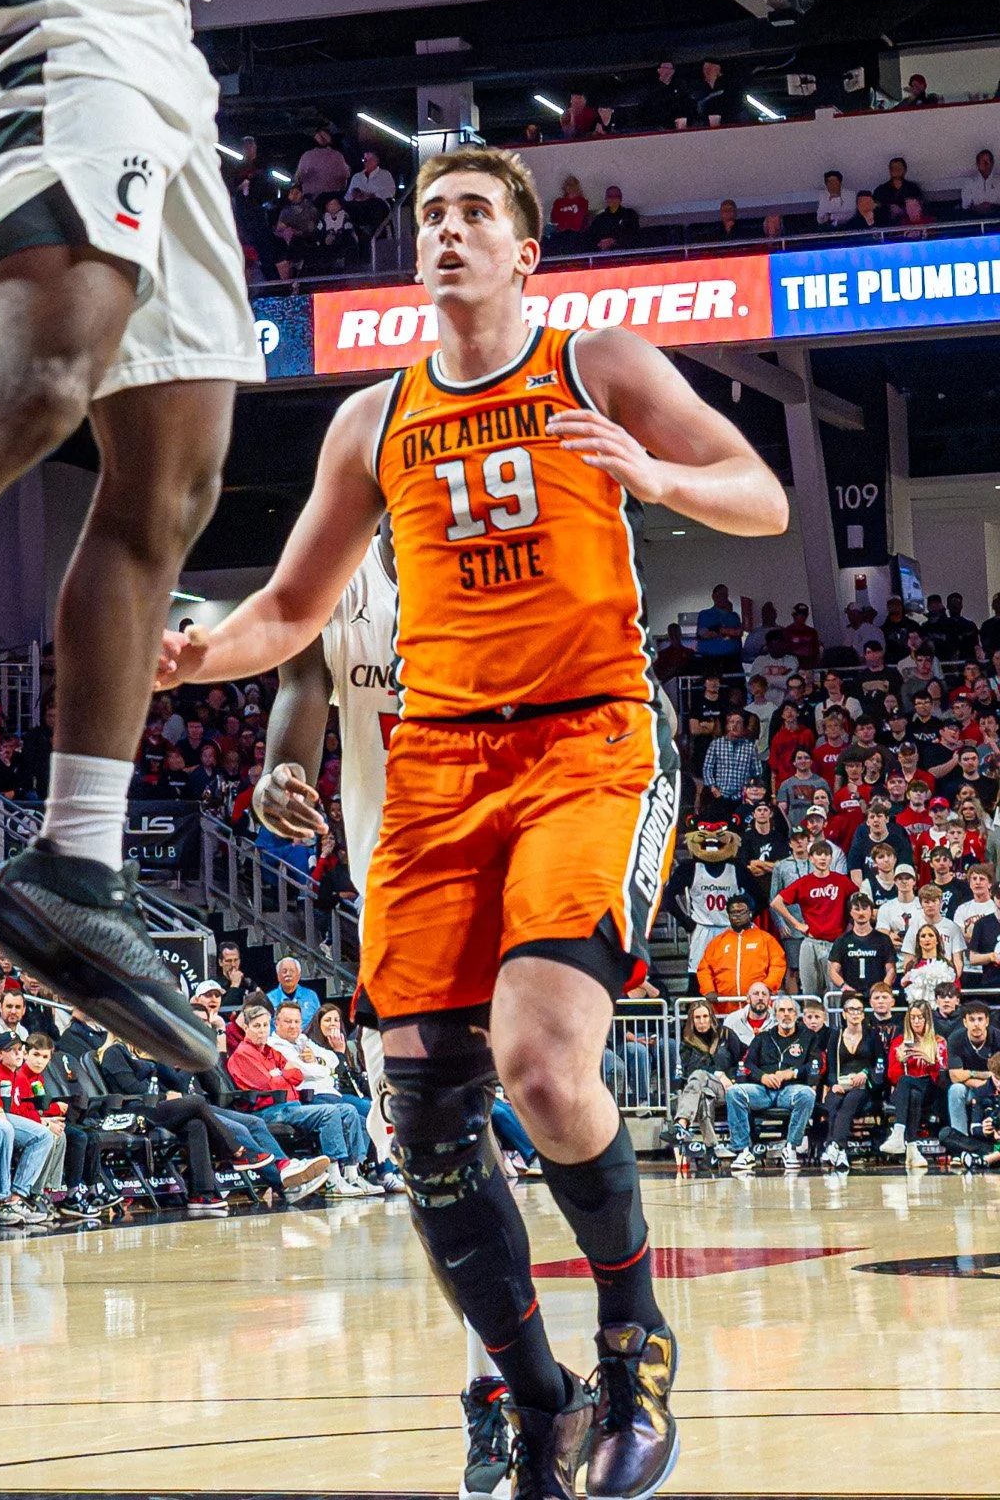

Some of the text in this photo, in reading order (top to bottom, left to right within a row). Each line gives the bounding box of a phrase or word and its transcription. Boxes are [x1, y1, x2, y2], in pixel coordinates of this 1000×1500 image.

[780, 272, 849, 311] THE
[434, 445, 540, 543] 19
[835, 483, 879, 510] 109
[459, 539, 544, 589] STATE
[634, 775, 675, 903] COWBOYS
[128, 846, 177, 858] CLUB
[706, 894, 727, 911] 00
[810, 884, 839, 901] CINCY
[847, 949, 878, 957] CINCINNATI
[859, 958, 865, 979] 1
